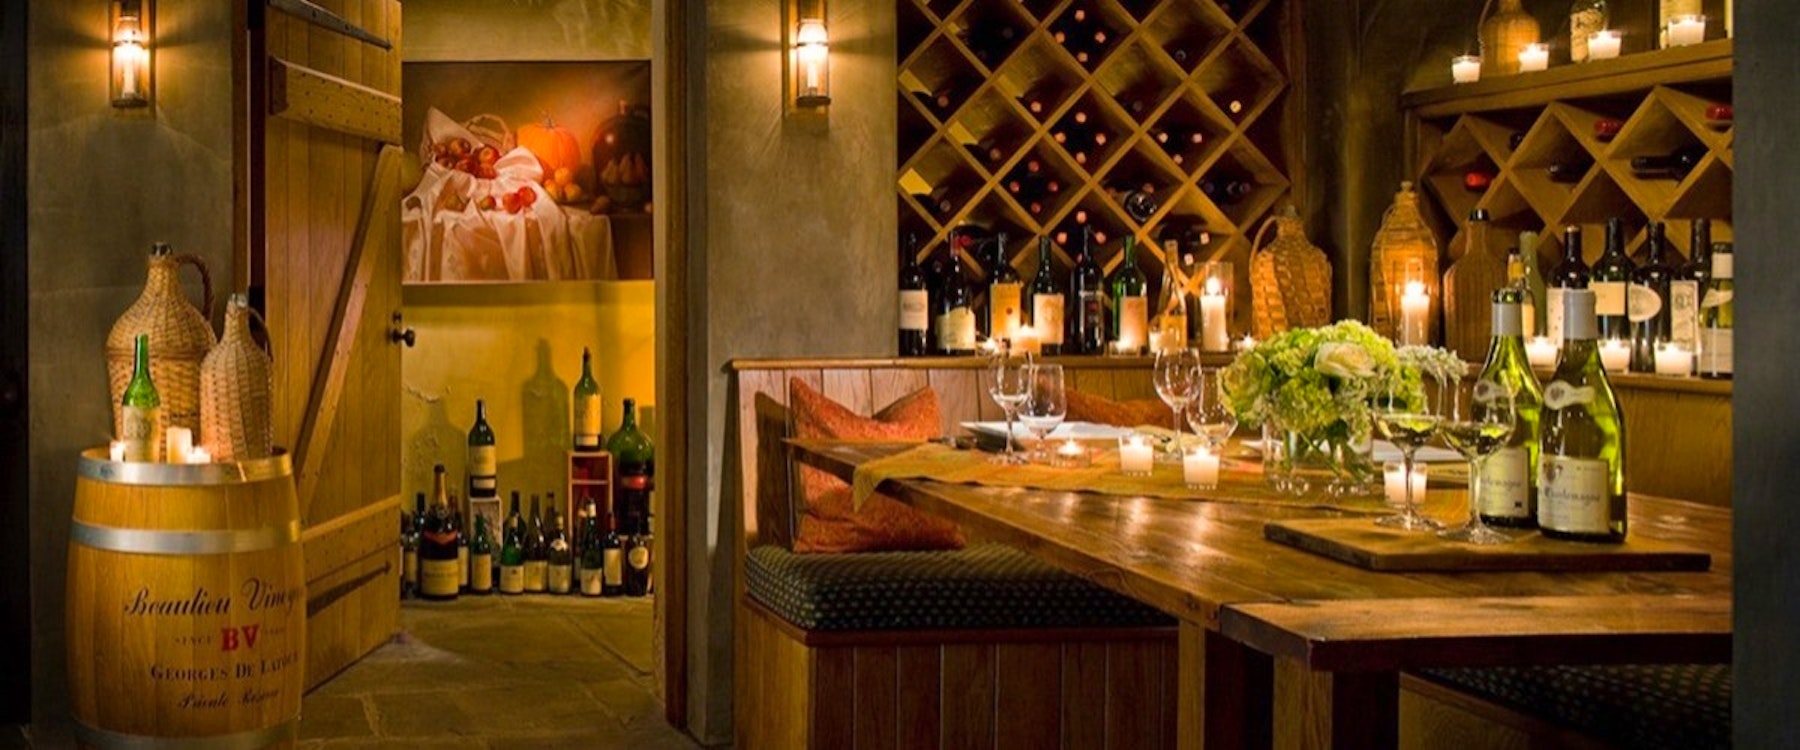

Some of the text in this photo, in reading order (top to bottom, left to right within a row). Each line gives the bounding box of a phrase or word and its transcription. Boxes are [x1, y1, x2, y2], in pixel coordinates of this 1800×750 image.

[124, 587, 231, 616] Beaulieu
[221, 624, 260, 654] BV
[150, 665, 228, 681] GEORGES
